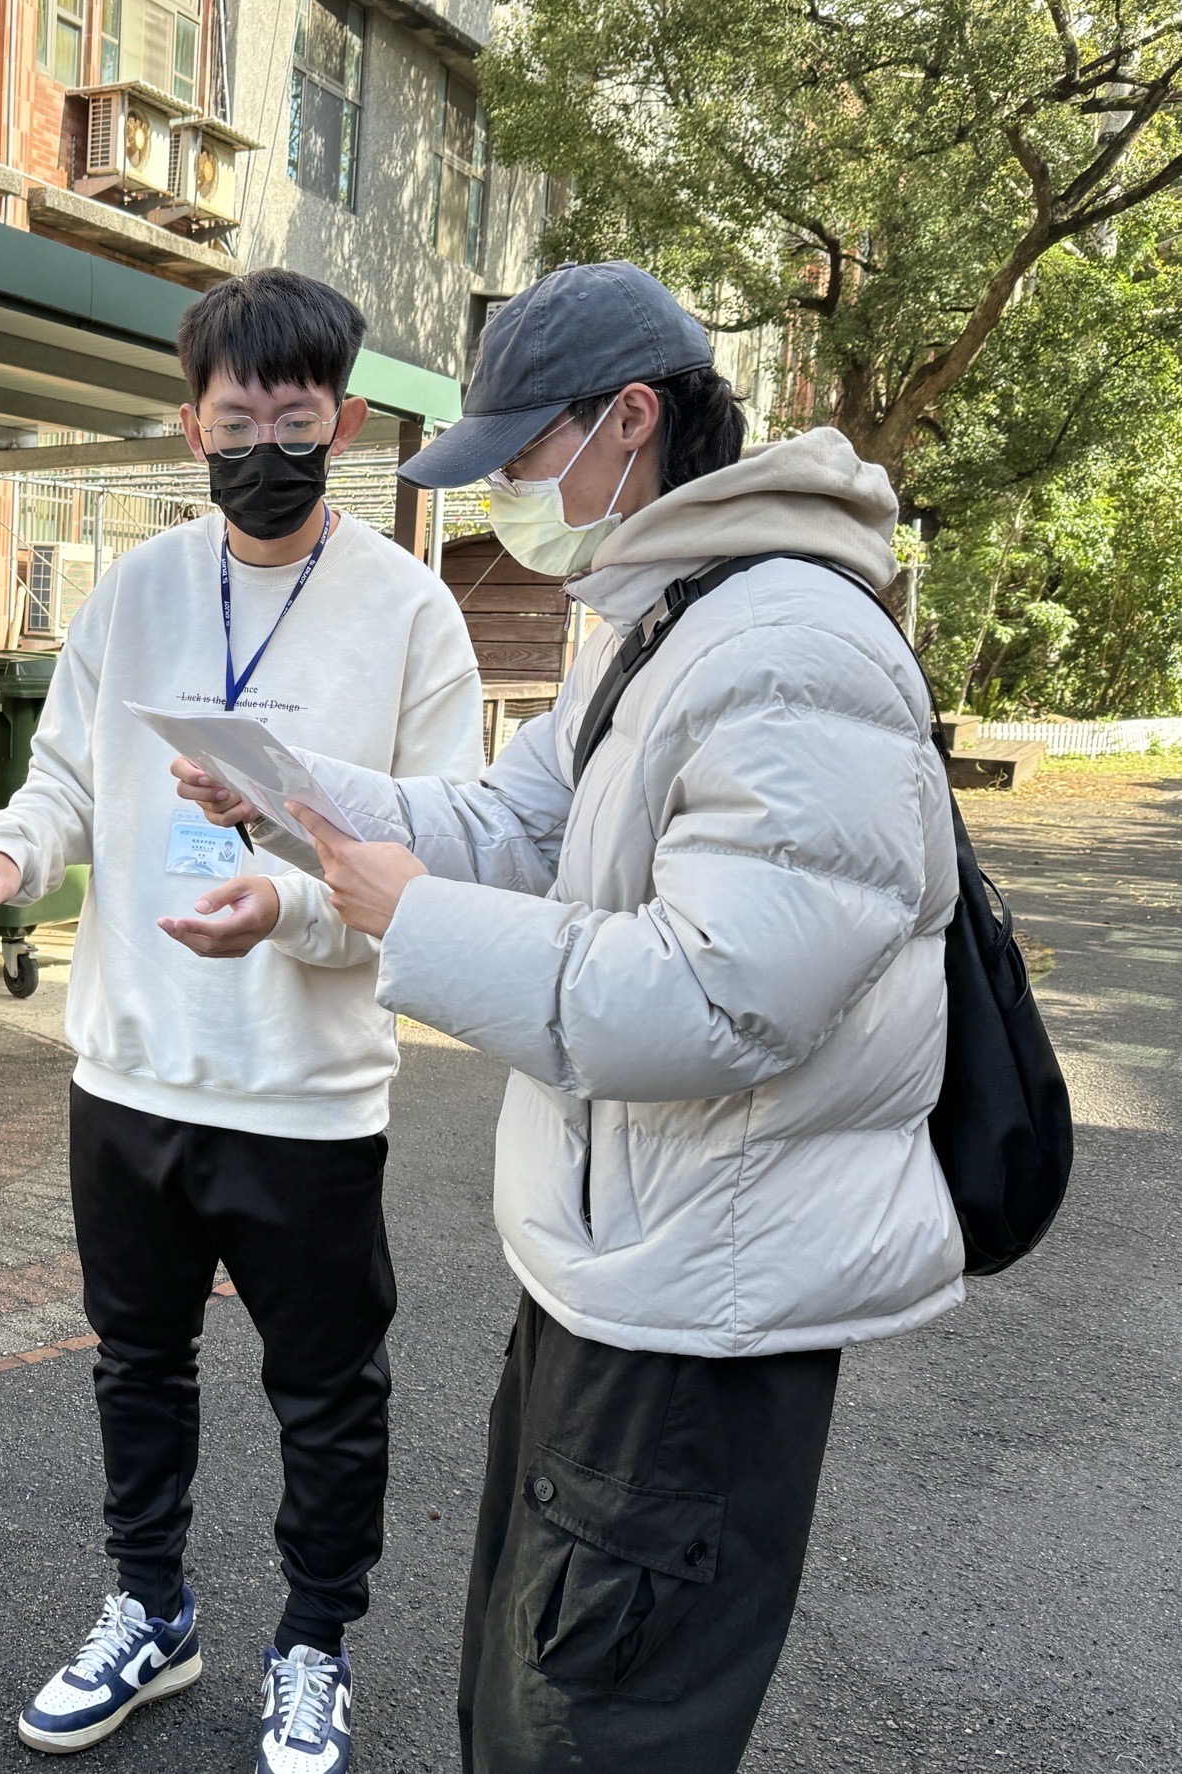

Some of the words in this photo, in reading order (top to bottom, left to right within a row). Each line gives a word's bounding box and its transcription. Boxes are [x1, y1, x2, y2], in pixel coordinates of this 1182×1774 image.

[181, 691, 202, 702] Luck
[203, 693, 211, 703] is
[212, 695, 226, 705] the
[234, 698, 257, 708] sidue
[258, 699, 269, 709] of
[269, 699, 301, 713] Design
